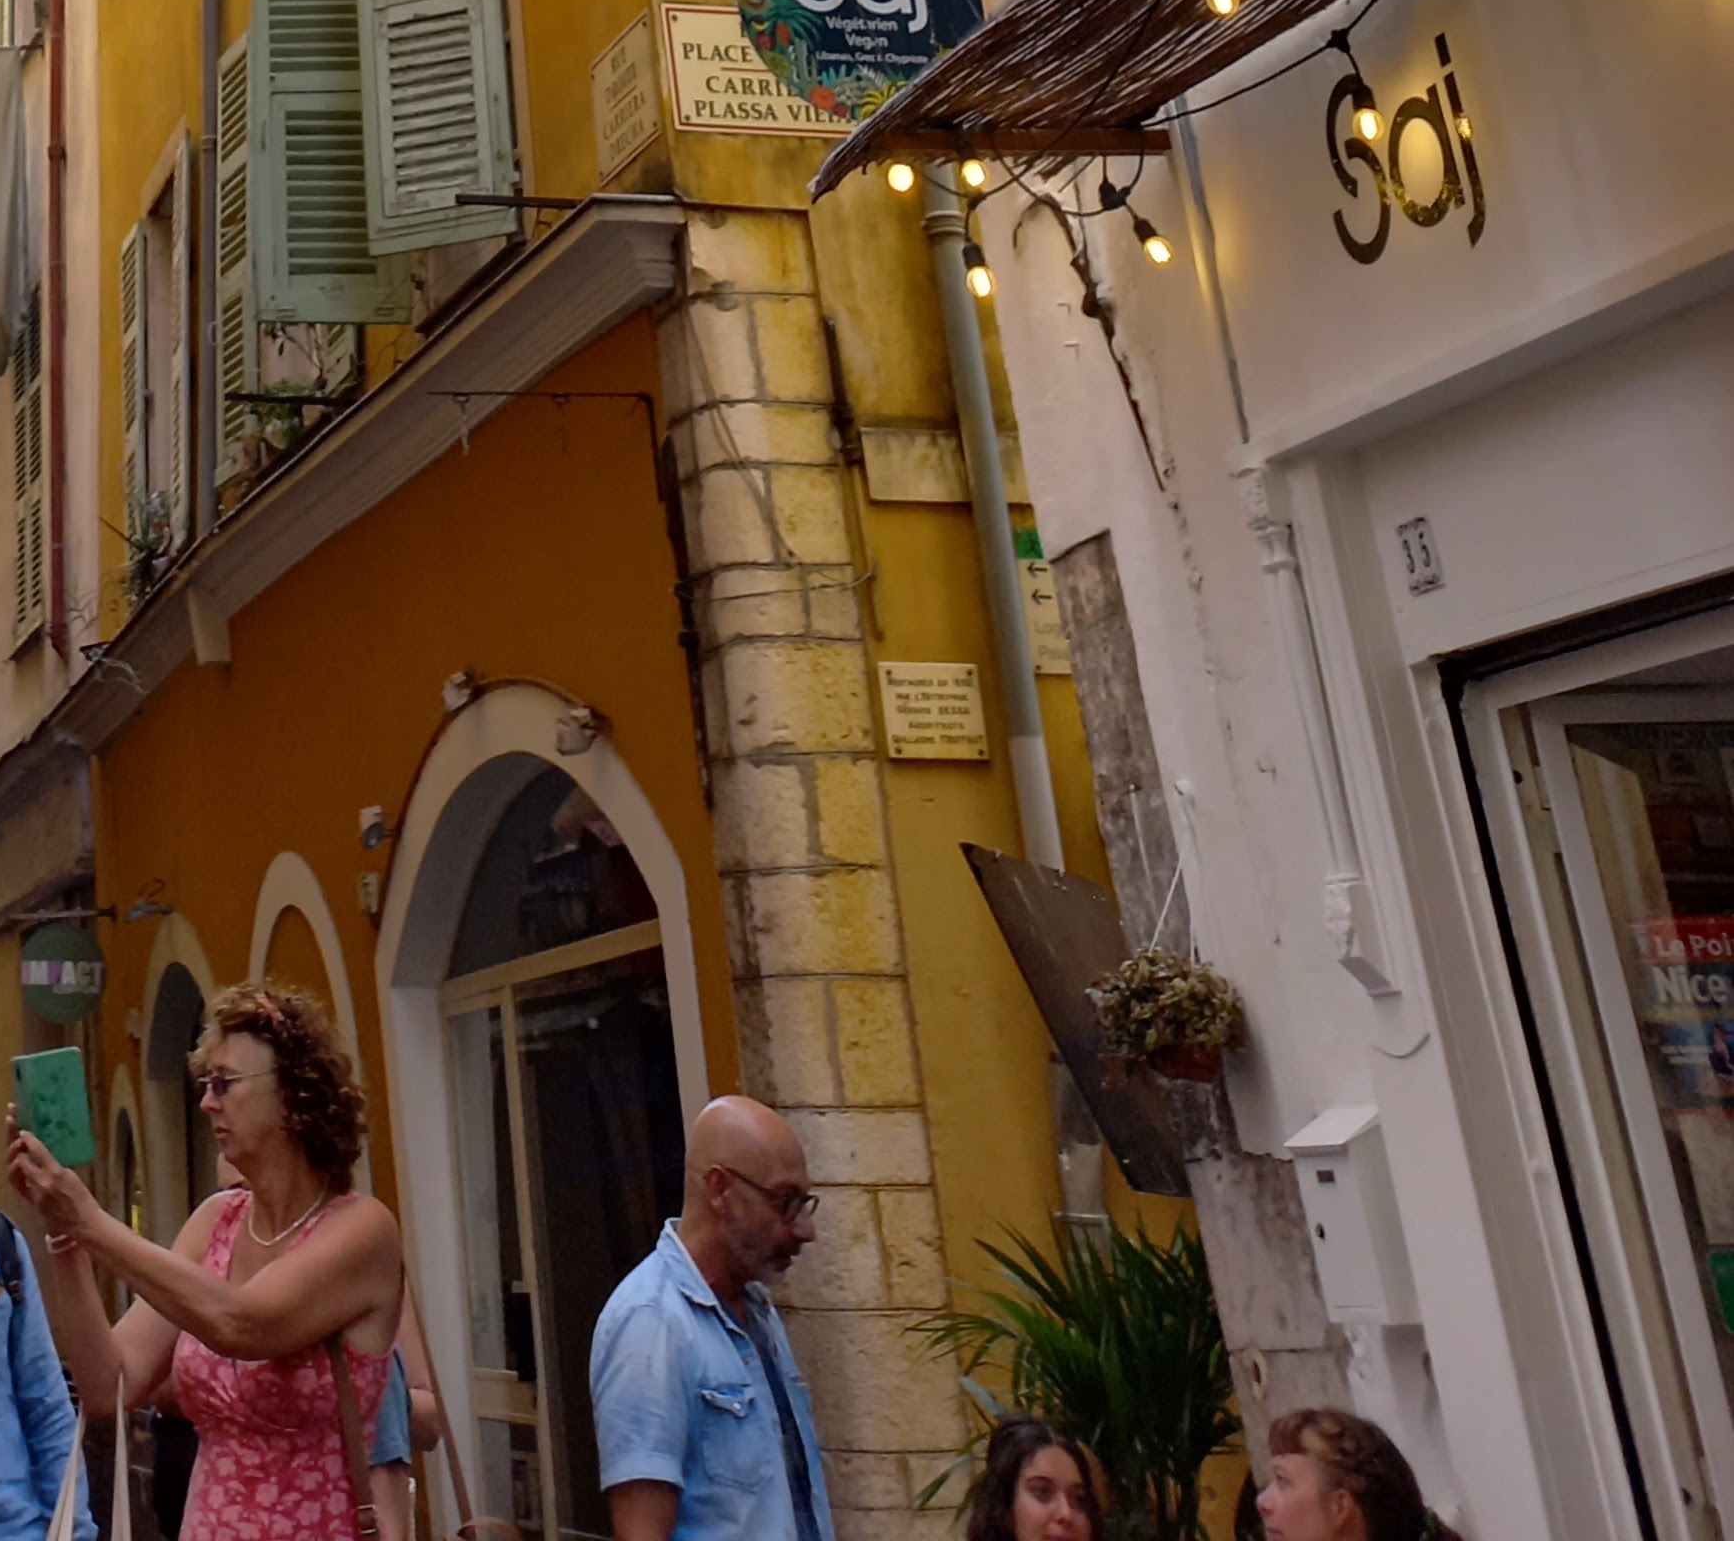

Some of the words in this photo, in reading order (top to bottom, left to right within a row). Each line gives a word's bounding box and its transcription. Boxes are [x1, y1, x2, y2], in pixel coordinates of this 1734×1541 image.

[681, 42, 754, 63] PLACE
[694, 99, 780, 122] PLASSA
[1325, 32, 1487, 265] Saj
[1688, 931, 1734, 958] Poi
[1652, 965, 1728, 1004] Nice
